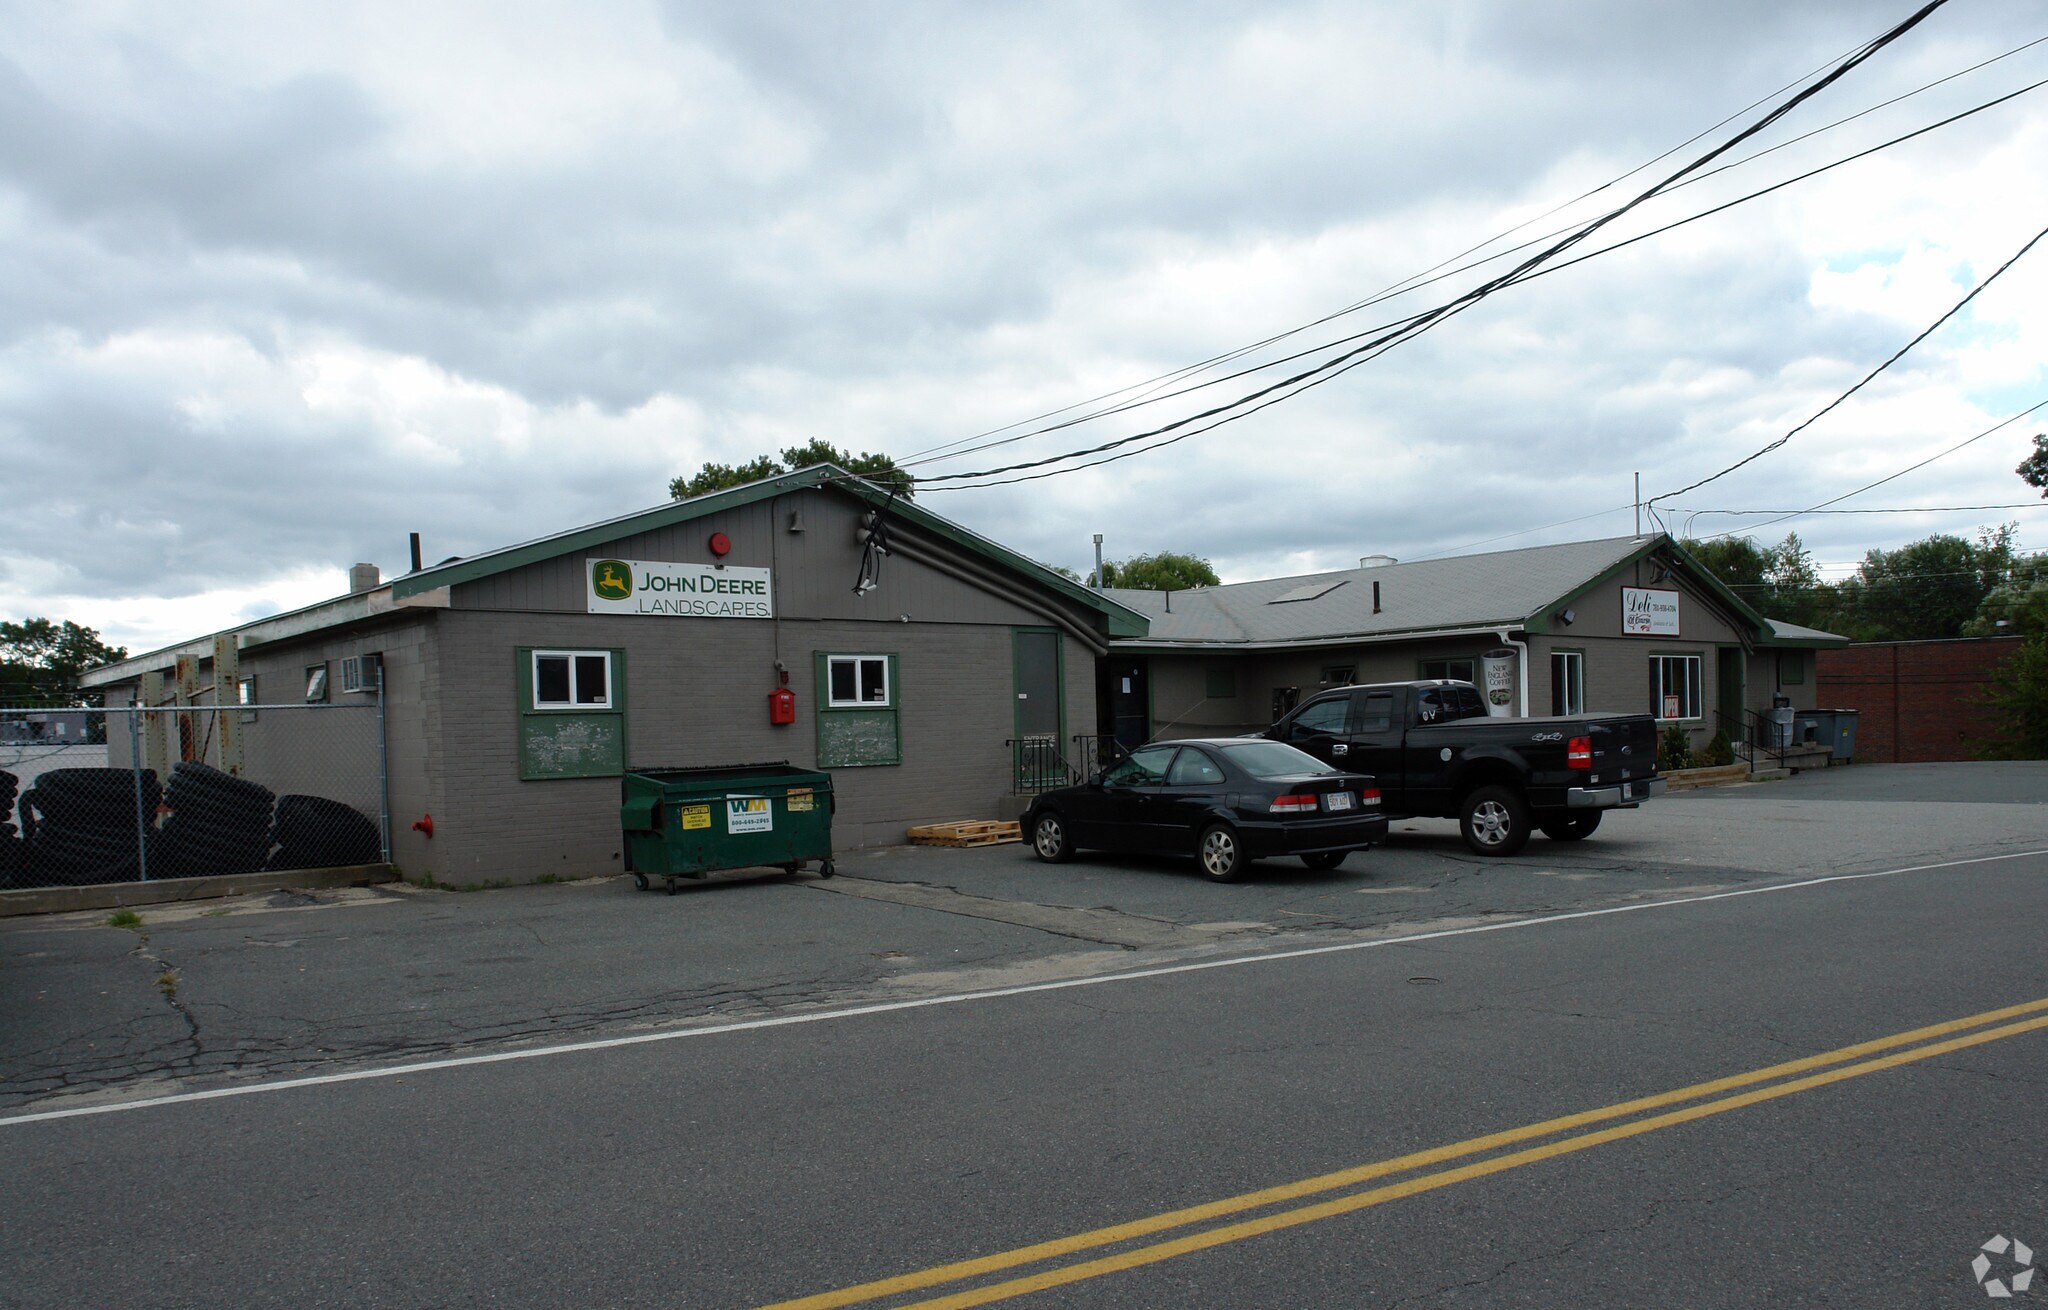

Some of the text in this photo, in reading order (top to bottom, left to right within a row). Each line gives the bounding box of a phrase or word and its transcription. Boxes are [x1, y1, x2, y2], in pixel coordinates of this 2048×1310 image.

[638, 572, 767, 595] JOHN DEERE
[639, 598, 768, 616] LANDSCAPES
[1627, 591, 1651, 612] Deli
[1023, 735, 1056, 743] ENTRANCE
[730, 799, 767, 813] WM
